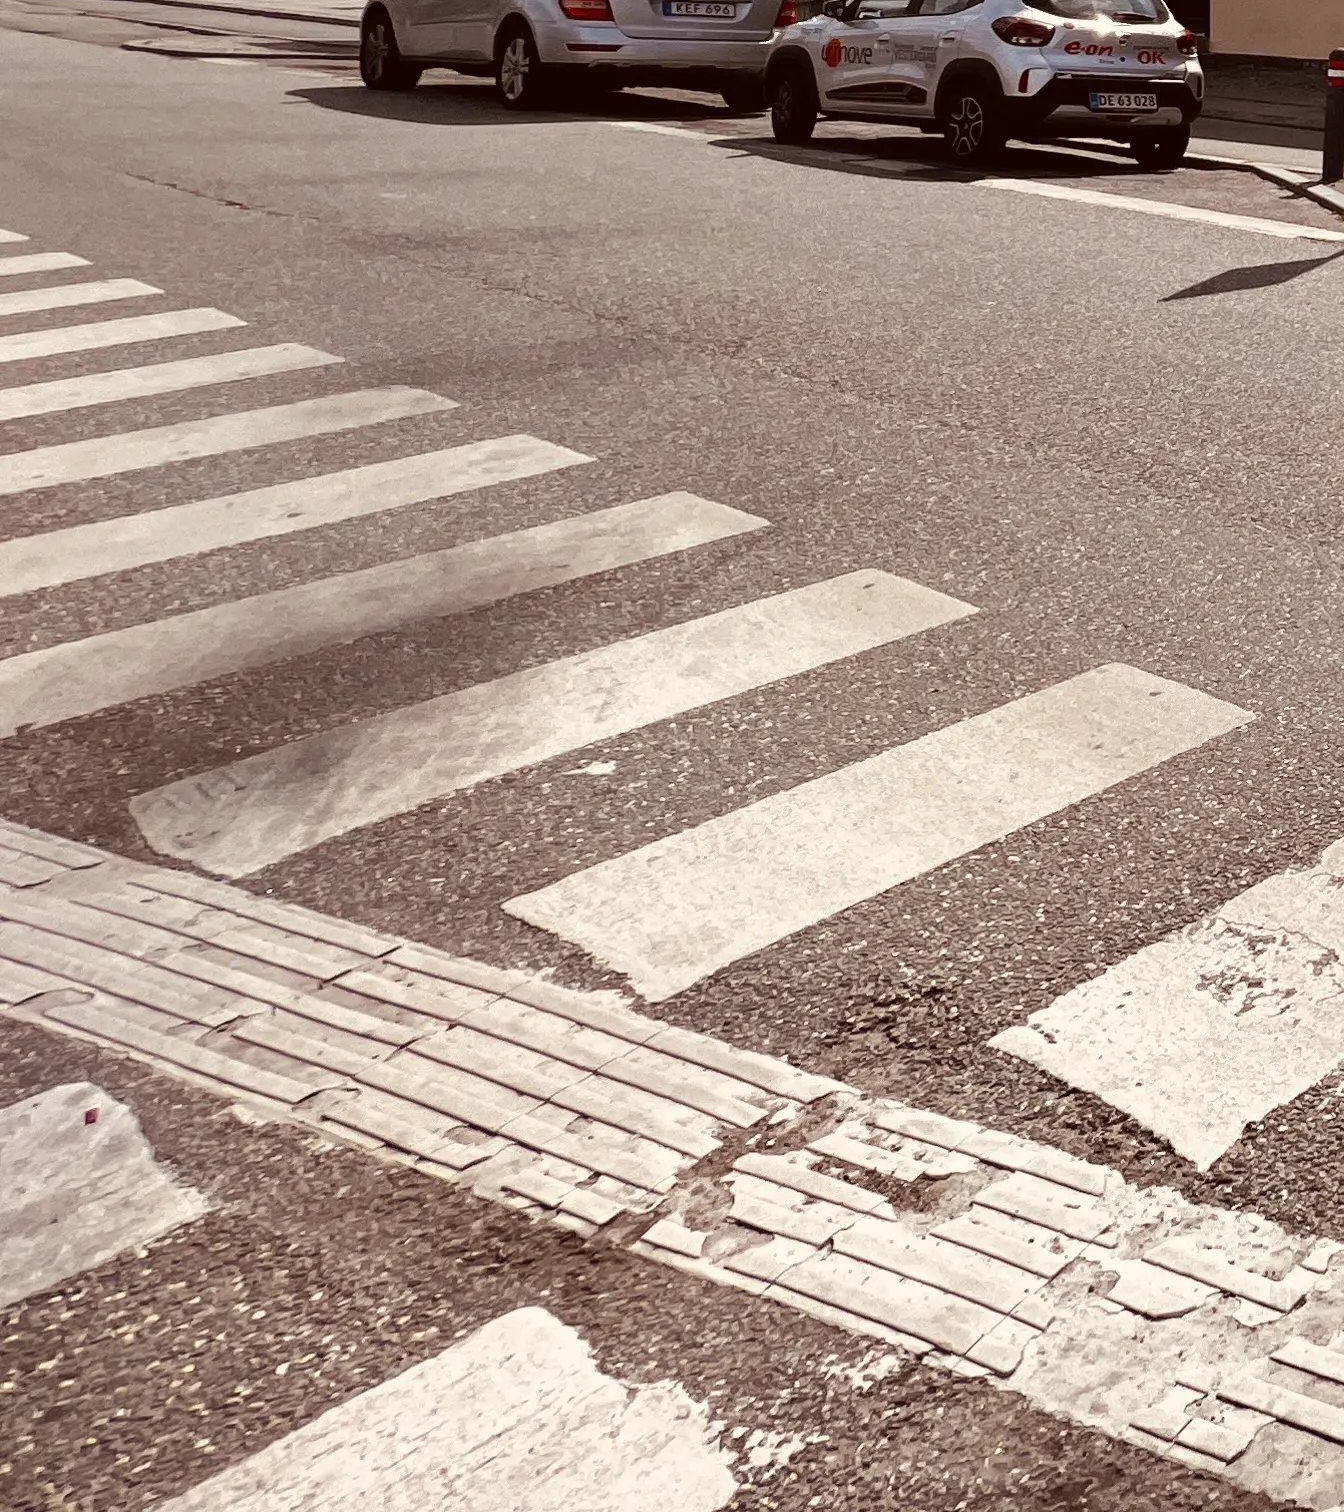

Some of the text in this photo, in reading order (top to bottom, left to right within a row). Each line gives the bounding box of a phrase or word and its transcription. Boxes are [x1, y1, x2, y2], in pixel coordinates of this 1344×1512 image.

[675, 3, 730, 15] KEF 696
[1137, 51, 1166, 65] OK
[1100, 94, 1156, 107] DE 63 028
